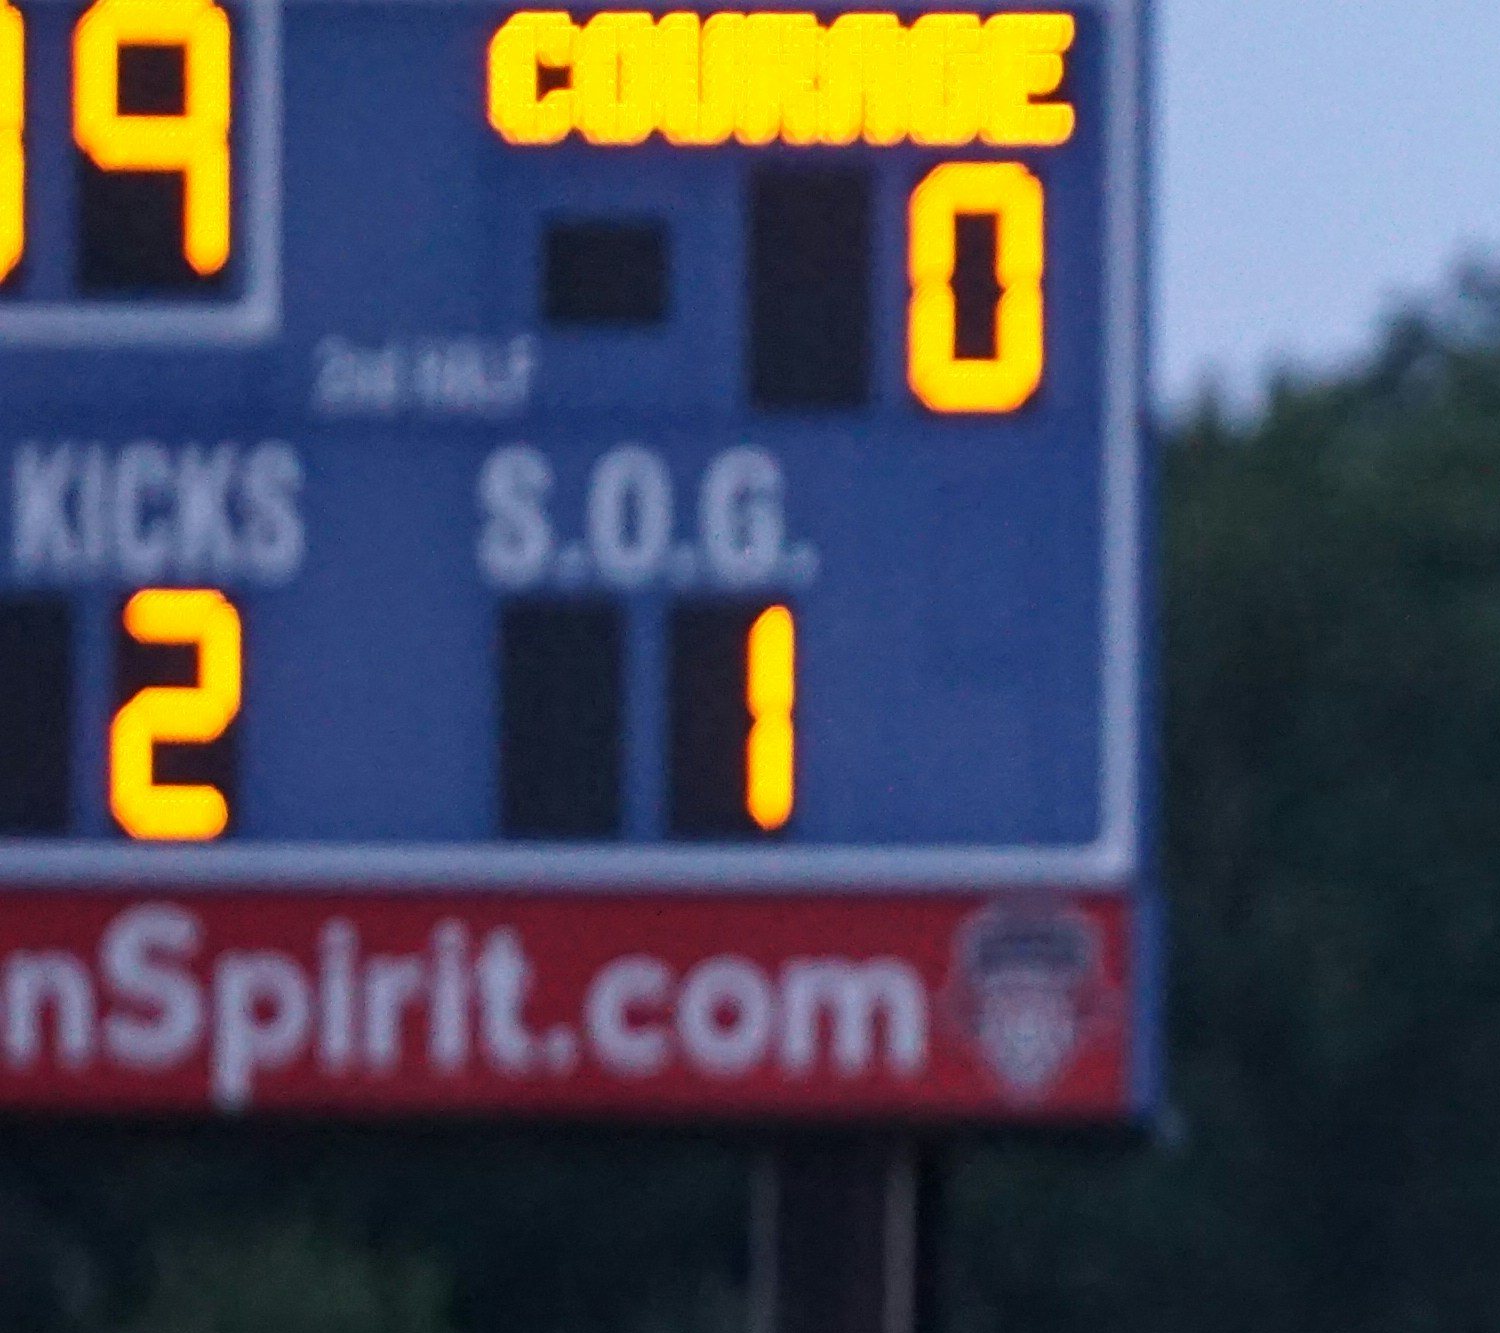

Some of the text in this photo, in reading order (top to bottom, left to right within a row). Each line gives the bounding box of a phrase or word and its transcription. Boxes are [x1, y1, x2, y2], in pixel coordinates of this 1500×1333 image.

[0, 0, 231, 282] 9
[487, 10, 1075, 147] COURAGE
[908, 161, 1044, 413] 0
[14, 444, 303, 578] KICKS
[478, 446, 815, 582] S.O.G.
[109, 589, 241, 840] 2
[747, 605, 795, 829] 1
[0, 905, 926, 1108] nSpirit.com
